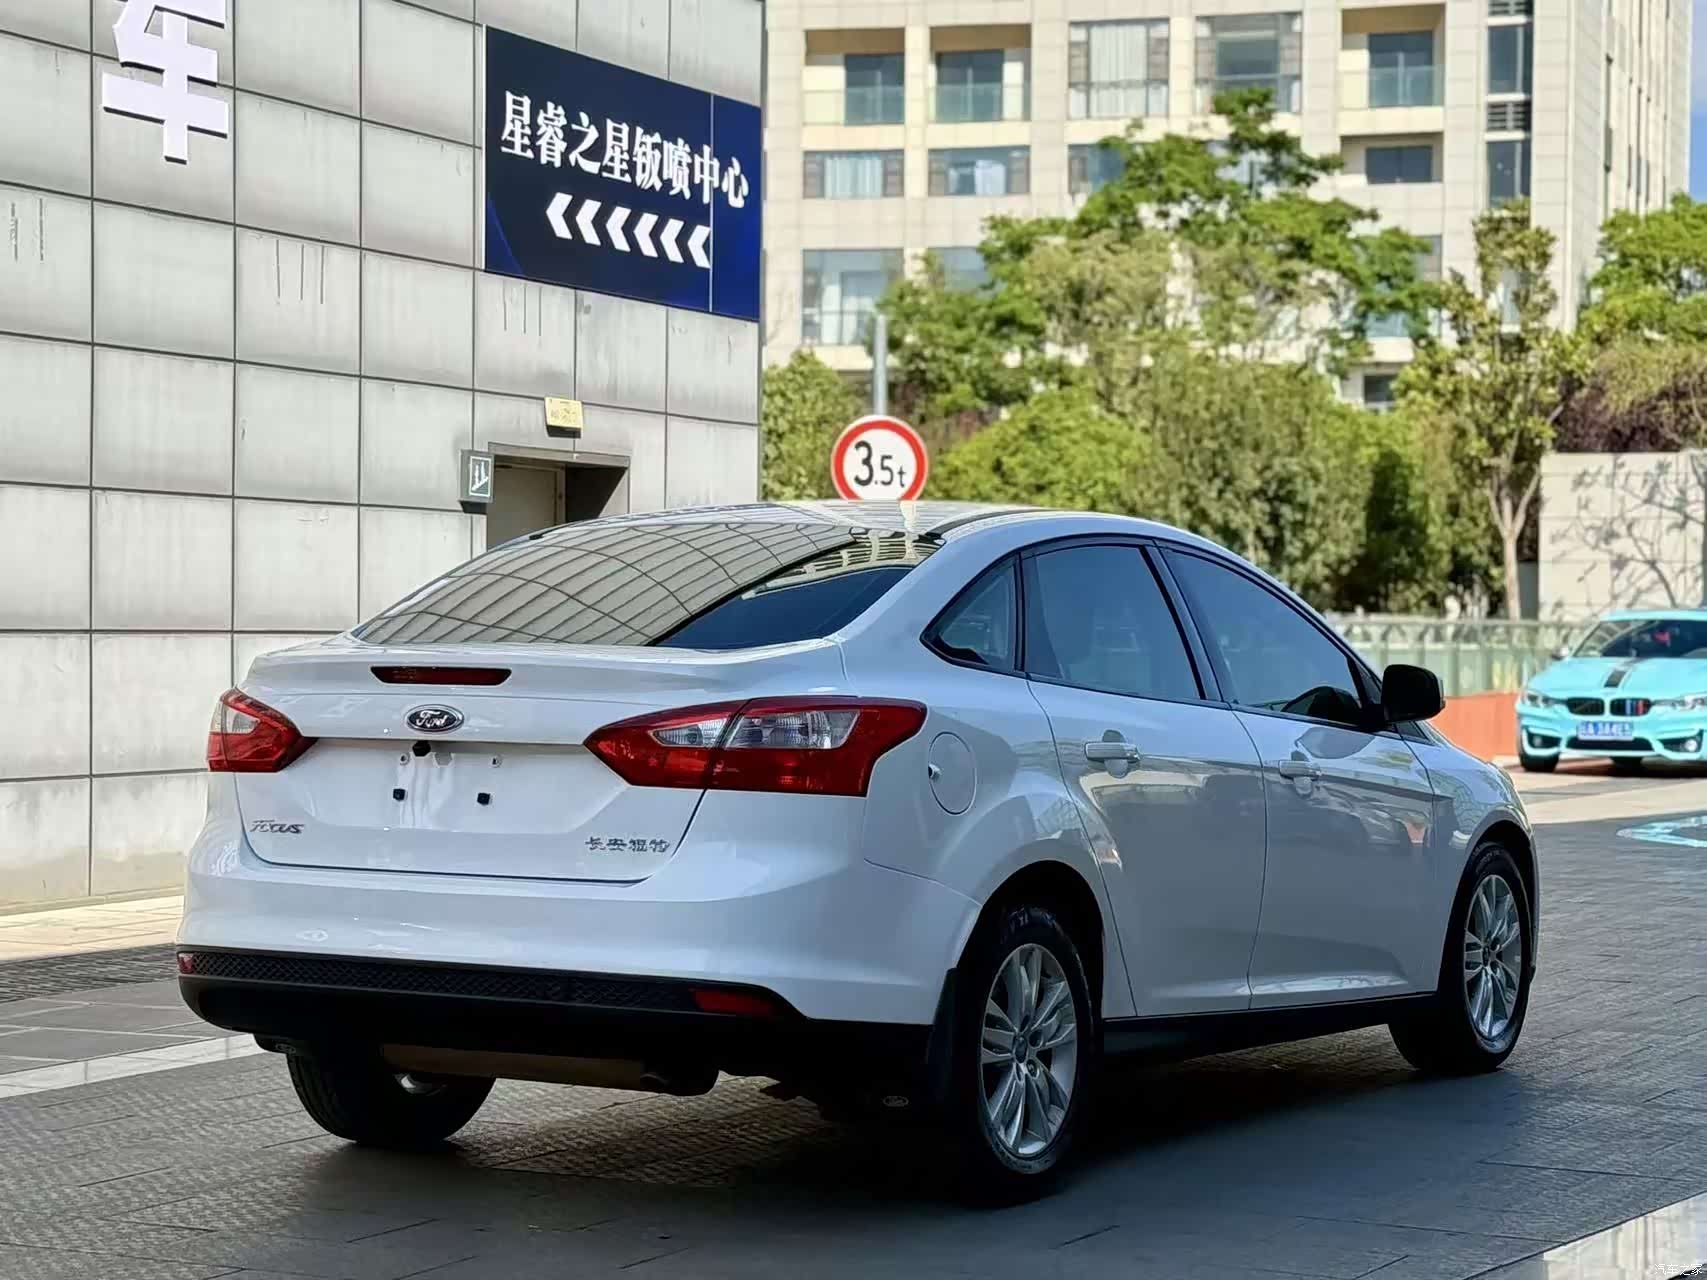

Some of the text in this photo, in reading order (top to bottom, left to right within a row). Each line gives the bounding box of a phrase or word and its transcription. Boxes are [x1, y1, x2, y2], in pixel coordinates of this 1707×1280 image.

[102, 0, 228, 162] 车
[501, 91, 749, 209] 星睿之星钣喷中心
[854, 440, 906, 488] 3.5t
[416, 710, 448, 728] Ford
[585, 836, 670, 853] 长安福特
